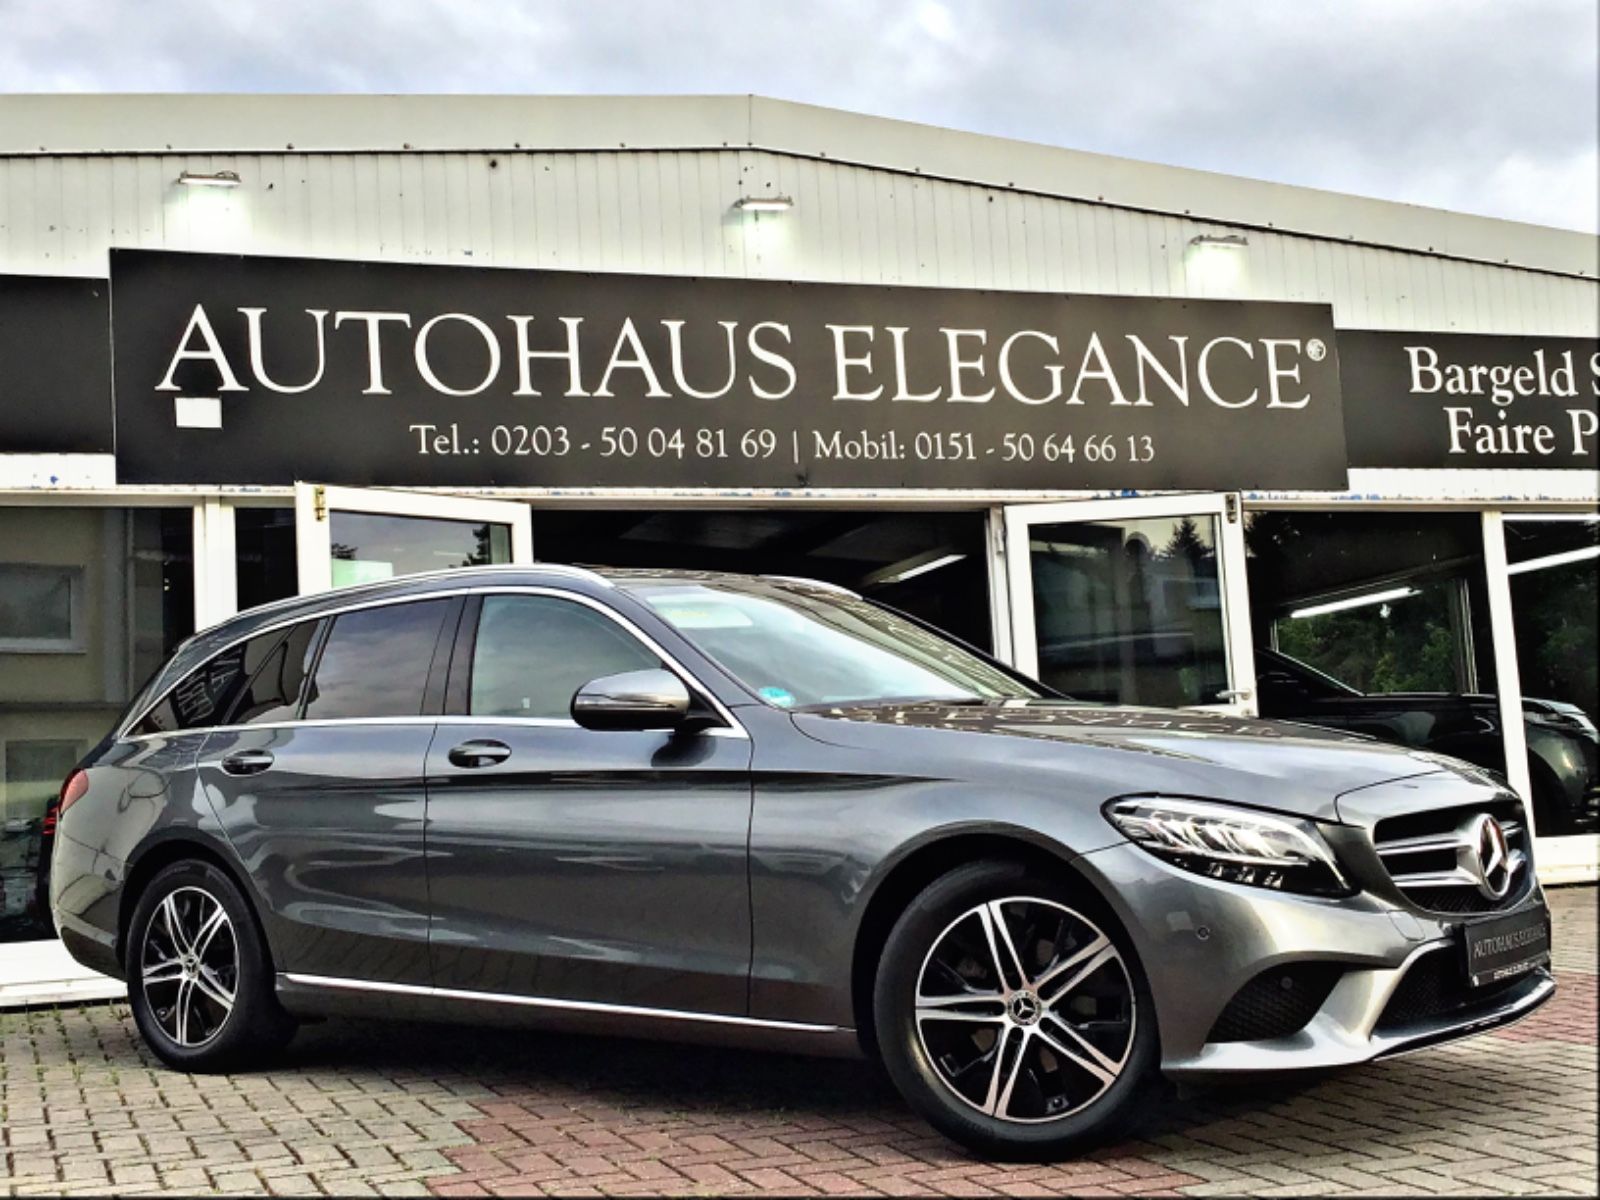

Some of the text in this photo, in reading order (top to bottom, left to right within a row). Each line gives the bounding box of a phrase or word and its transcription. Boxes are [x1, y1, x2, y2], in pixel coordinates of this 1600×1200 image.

[155, 304, 797, 402] AUTOHAUS
[1403, 346, 1579, 406] Bargeld
[409, 424, 480, 455] Tel.:
[491, 425, 571, 457] 0203
[599, 426, 639, 458] 50
[647, 427, 686, 460] 04
[695, 428, 729, 459] 81
[740, 428, 778, 460] 69
[811, 429, 906, 461] Mobil:
[914, 431, 978, 461] 0151
[1001, 432, 1035, 462] 50
[1042, 433, 1077, 464] 64
[1083, 434, 1117, 463] 66
[1125, 435, 1156, 463] 13
[1443, 407, 1556, 454] Faire
